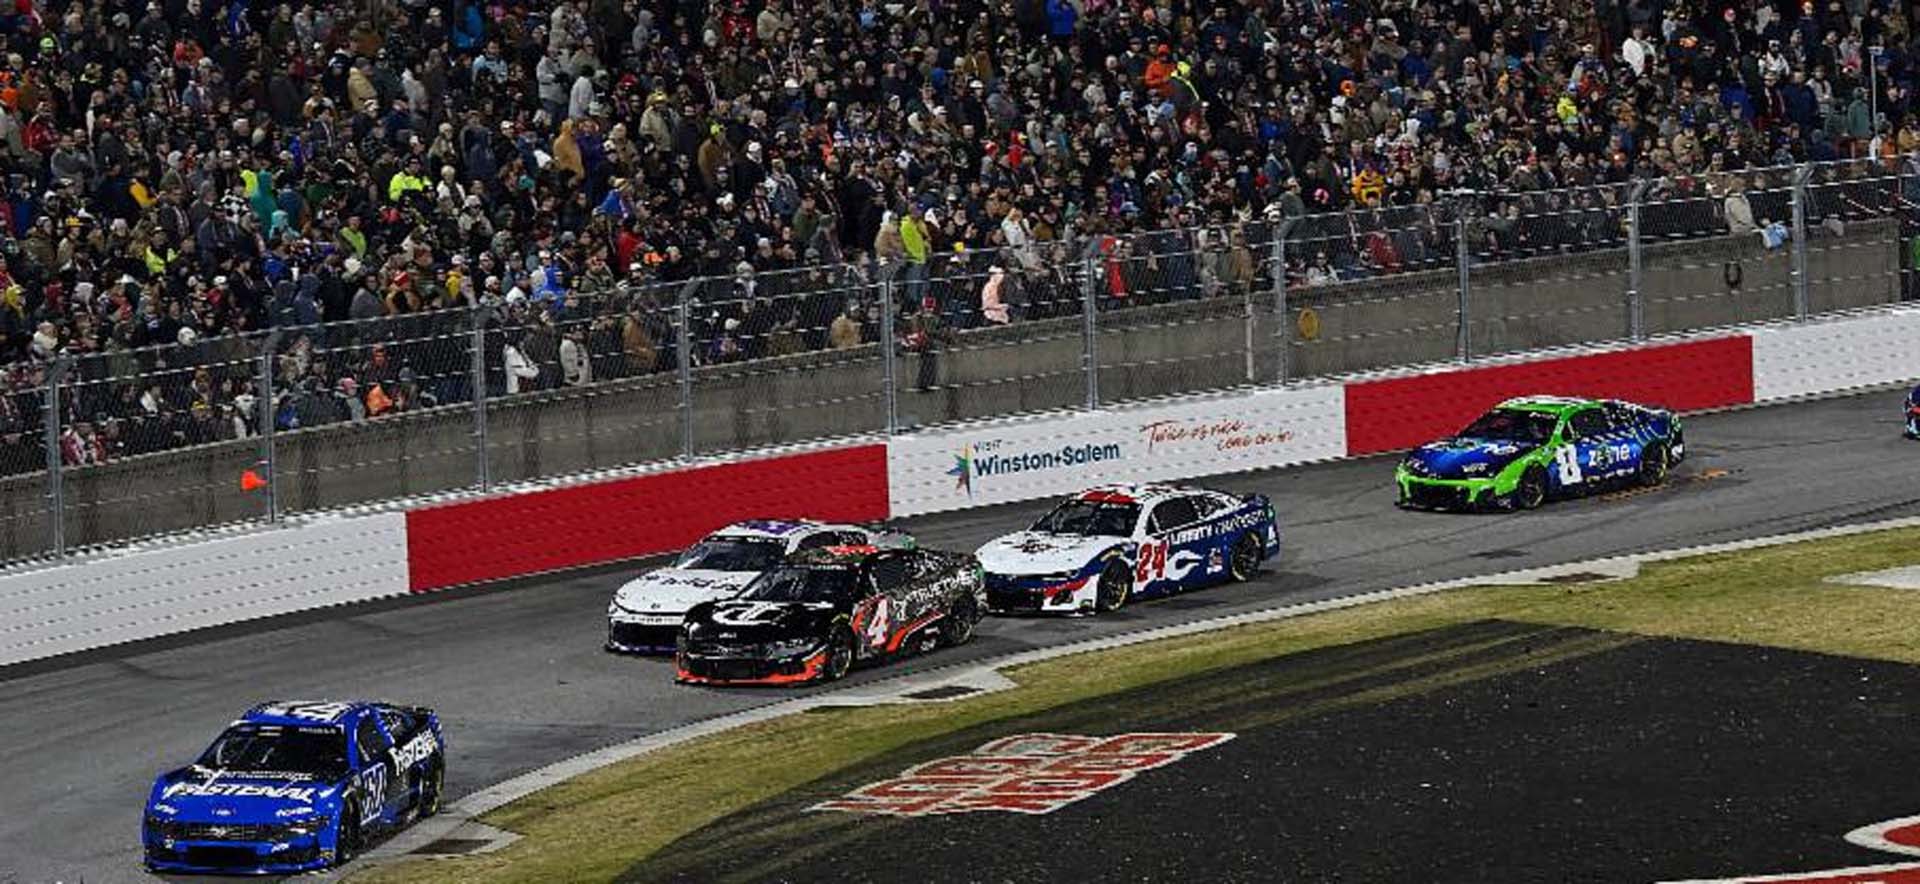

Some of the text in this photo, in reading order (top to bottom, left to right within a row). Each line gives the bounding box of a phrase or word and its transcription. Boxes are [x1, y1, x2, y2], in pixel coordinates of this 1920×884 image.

[1170, 524, 1213, 545] LIBERTY
[1136, 540, 1168, 583] 24
[867, 598, 889, 647] 4
